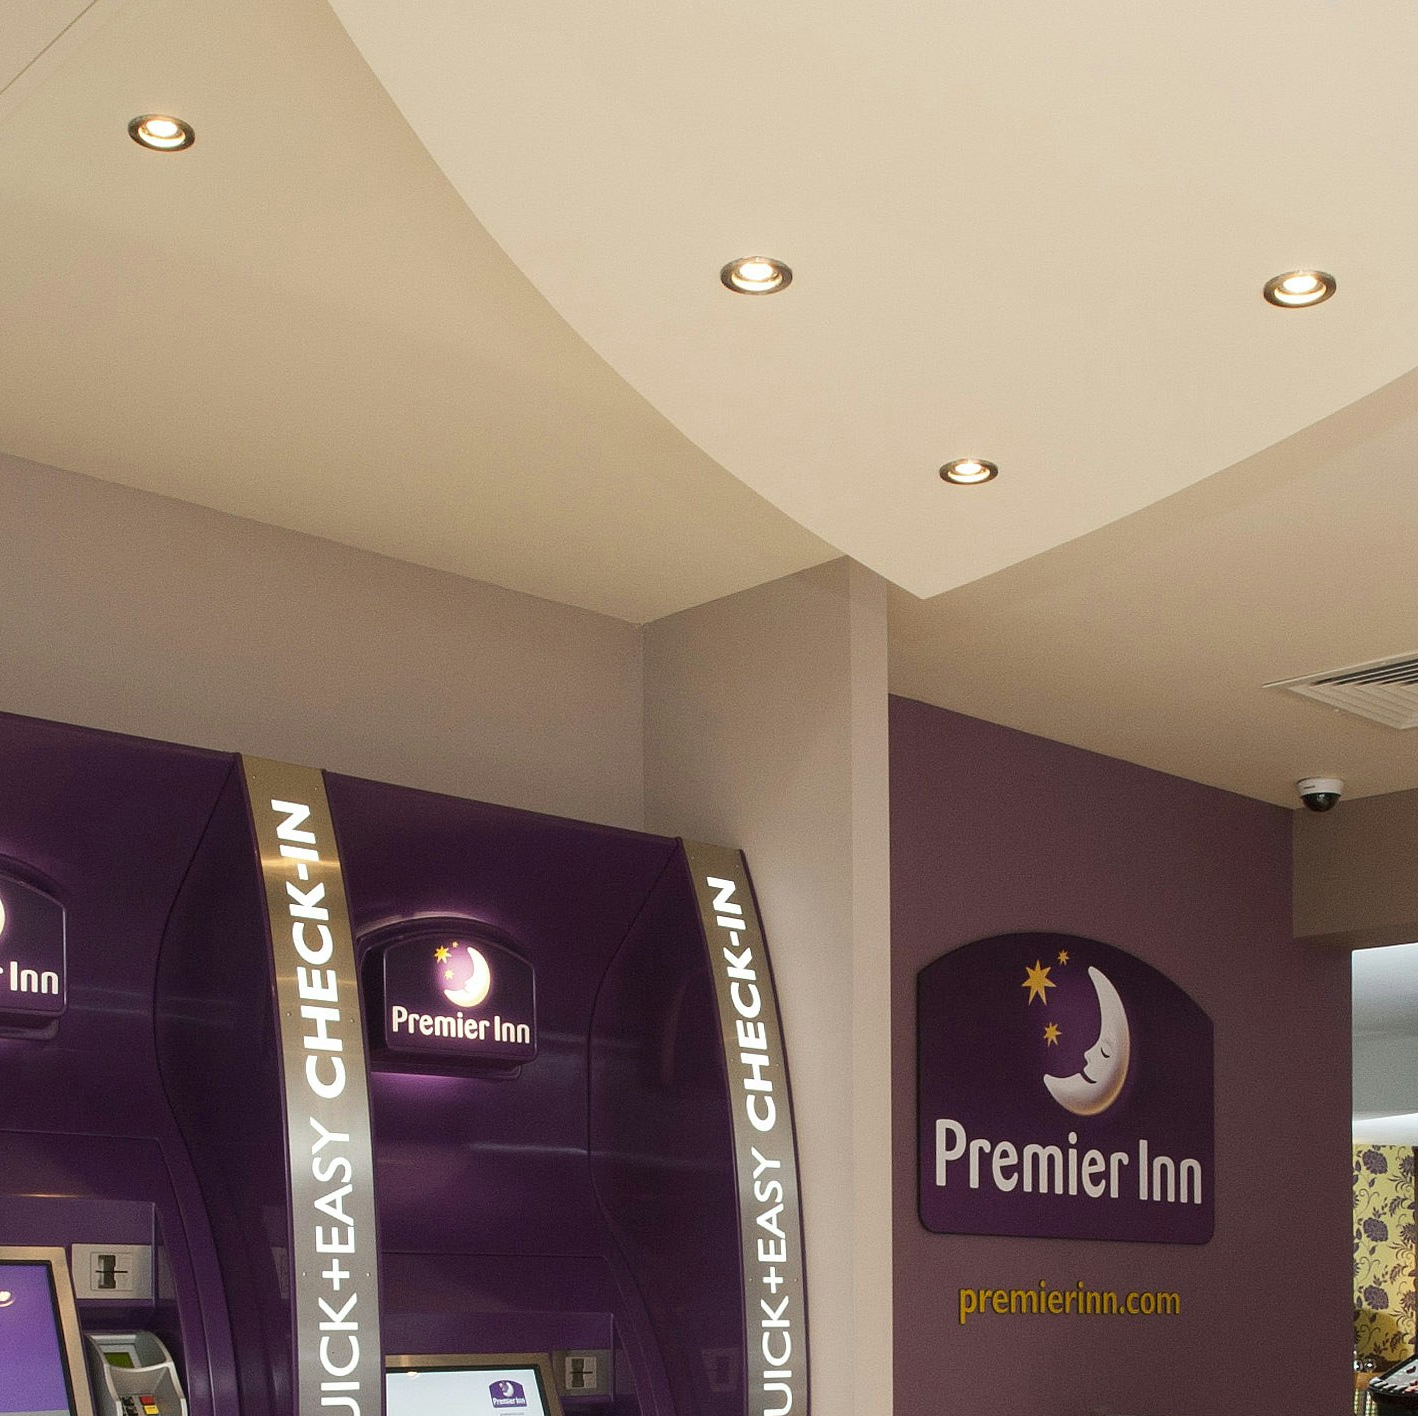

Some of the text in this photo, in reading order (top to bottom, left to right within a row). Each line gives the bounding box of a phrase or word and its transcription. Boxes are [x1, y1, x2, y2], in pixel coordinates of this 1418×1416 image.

[9, 961, 59, 993] Inn
[271, 799, 346, 1099] CHECK-IN
[392, 1005, 530, 1044] Premier Inn
[706, 876, 776, 1132] CHECK-IN
[935, 1118, 1202, 1204] Premier Inn
[959, 1279, 1181, 1325] premierinn.com
